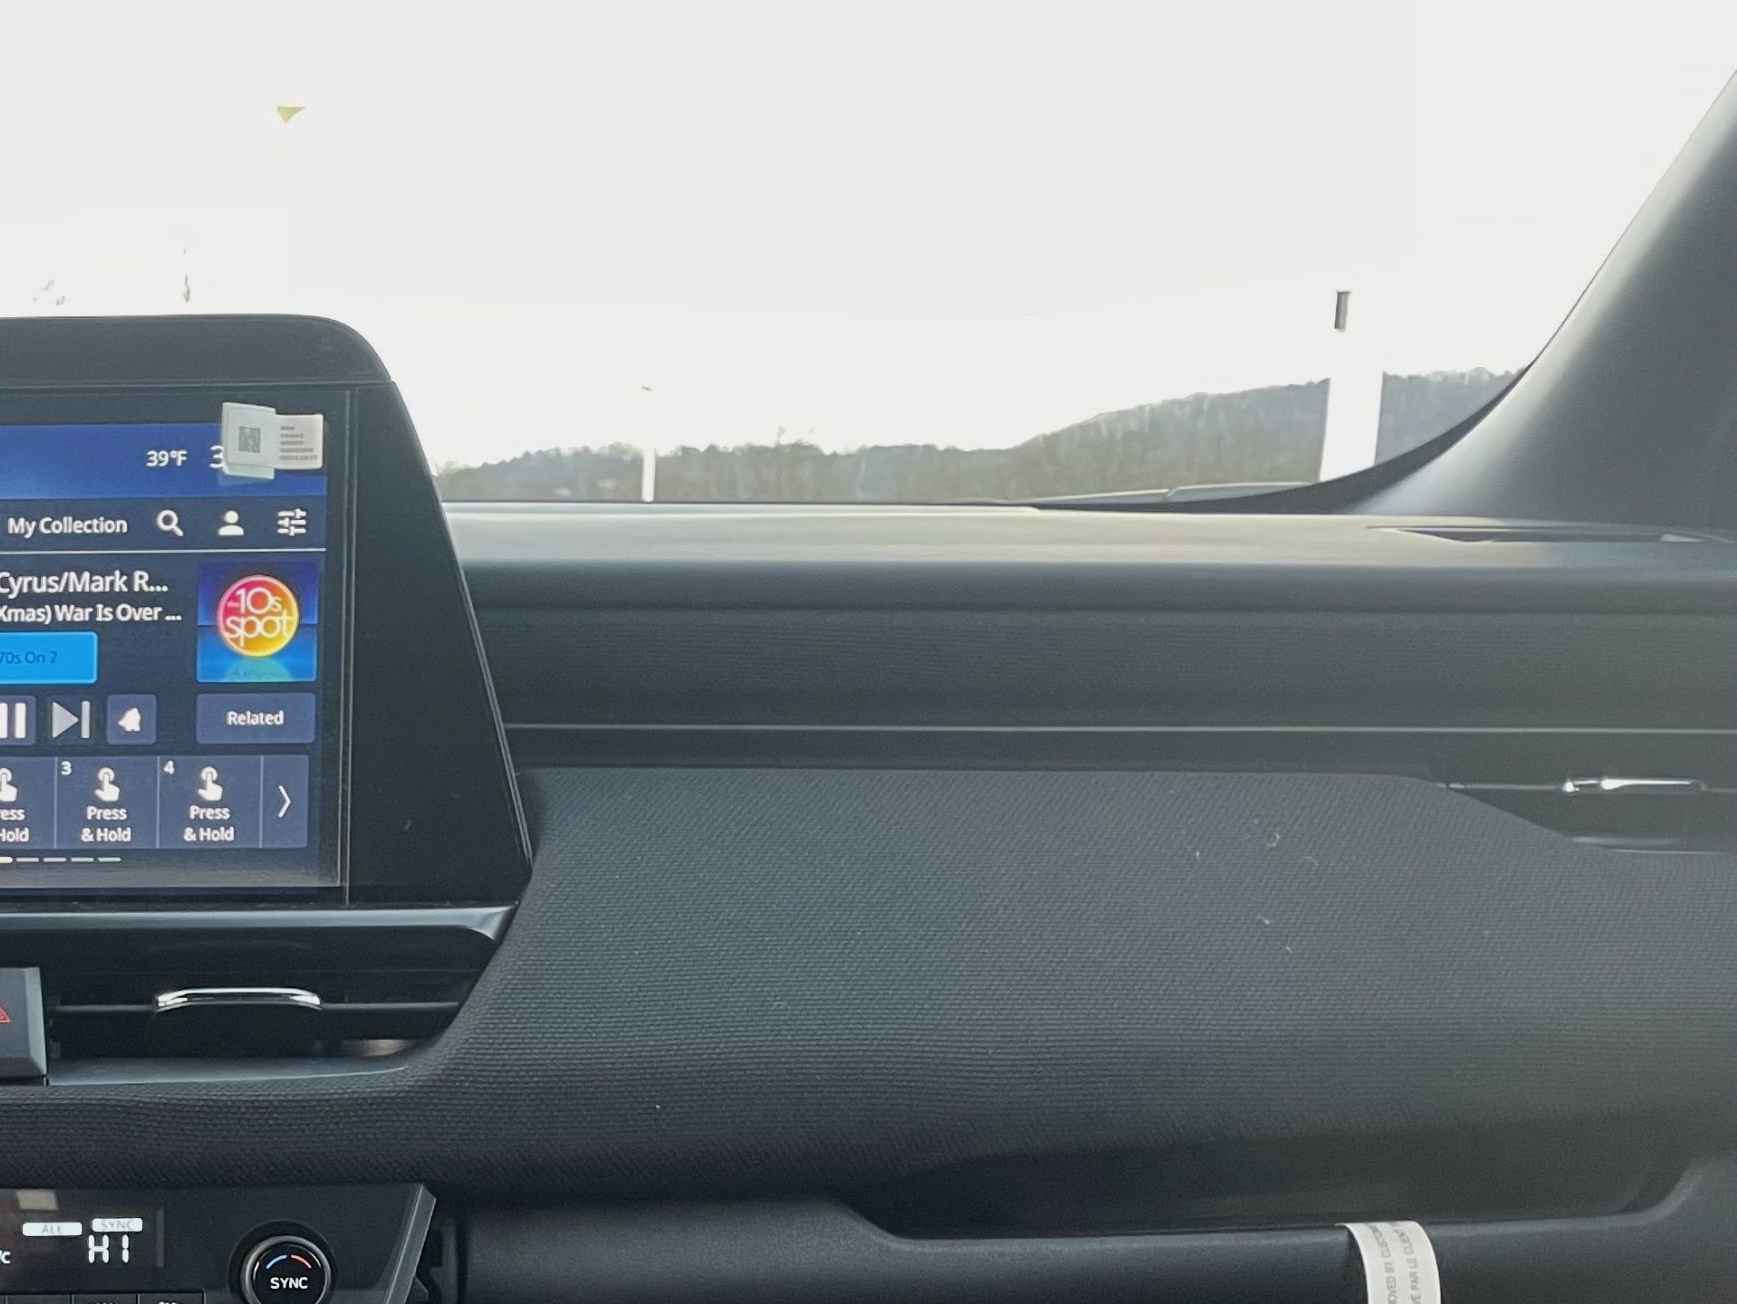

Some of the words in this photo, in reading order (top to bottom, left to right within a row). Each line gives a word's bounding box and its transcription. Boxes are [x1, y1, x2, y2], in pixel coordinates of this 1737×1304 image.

[7, 518, 36, 539] My
[39, 516, 128, 535] Collection
[133, 571, 169, 593] R...
[55, 604, 93, 622] War
[95, 604, 114, 621] Is
[116, 604, 162, 622] Over
[225, 609, 293, 648] spot
[25, 651, 46, 664] On
[49, 651, 58, 664] 7
[226, 709, 284, 726] Related
[61, 761, 72, 775] 3
[163, 760, 174, 775] 4
[86, 806, 127, 821] Press
[189, 805, 230, 820] Press
[81, 829, 94, 842] &
[96, 827, 131, 842] Hold
[183, 828, 197, 841] &
[199, 827, 234, 841] Hold
[41, 1224, 62, 1234] ALL
[101, 1220, 135, 1230] SYNC
[270, 1276, 308, 1290] SYNC
